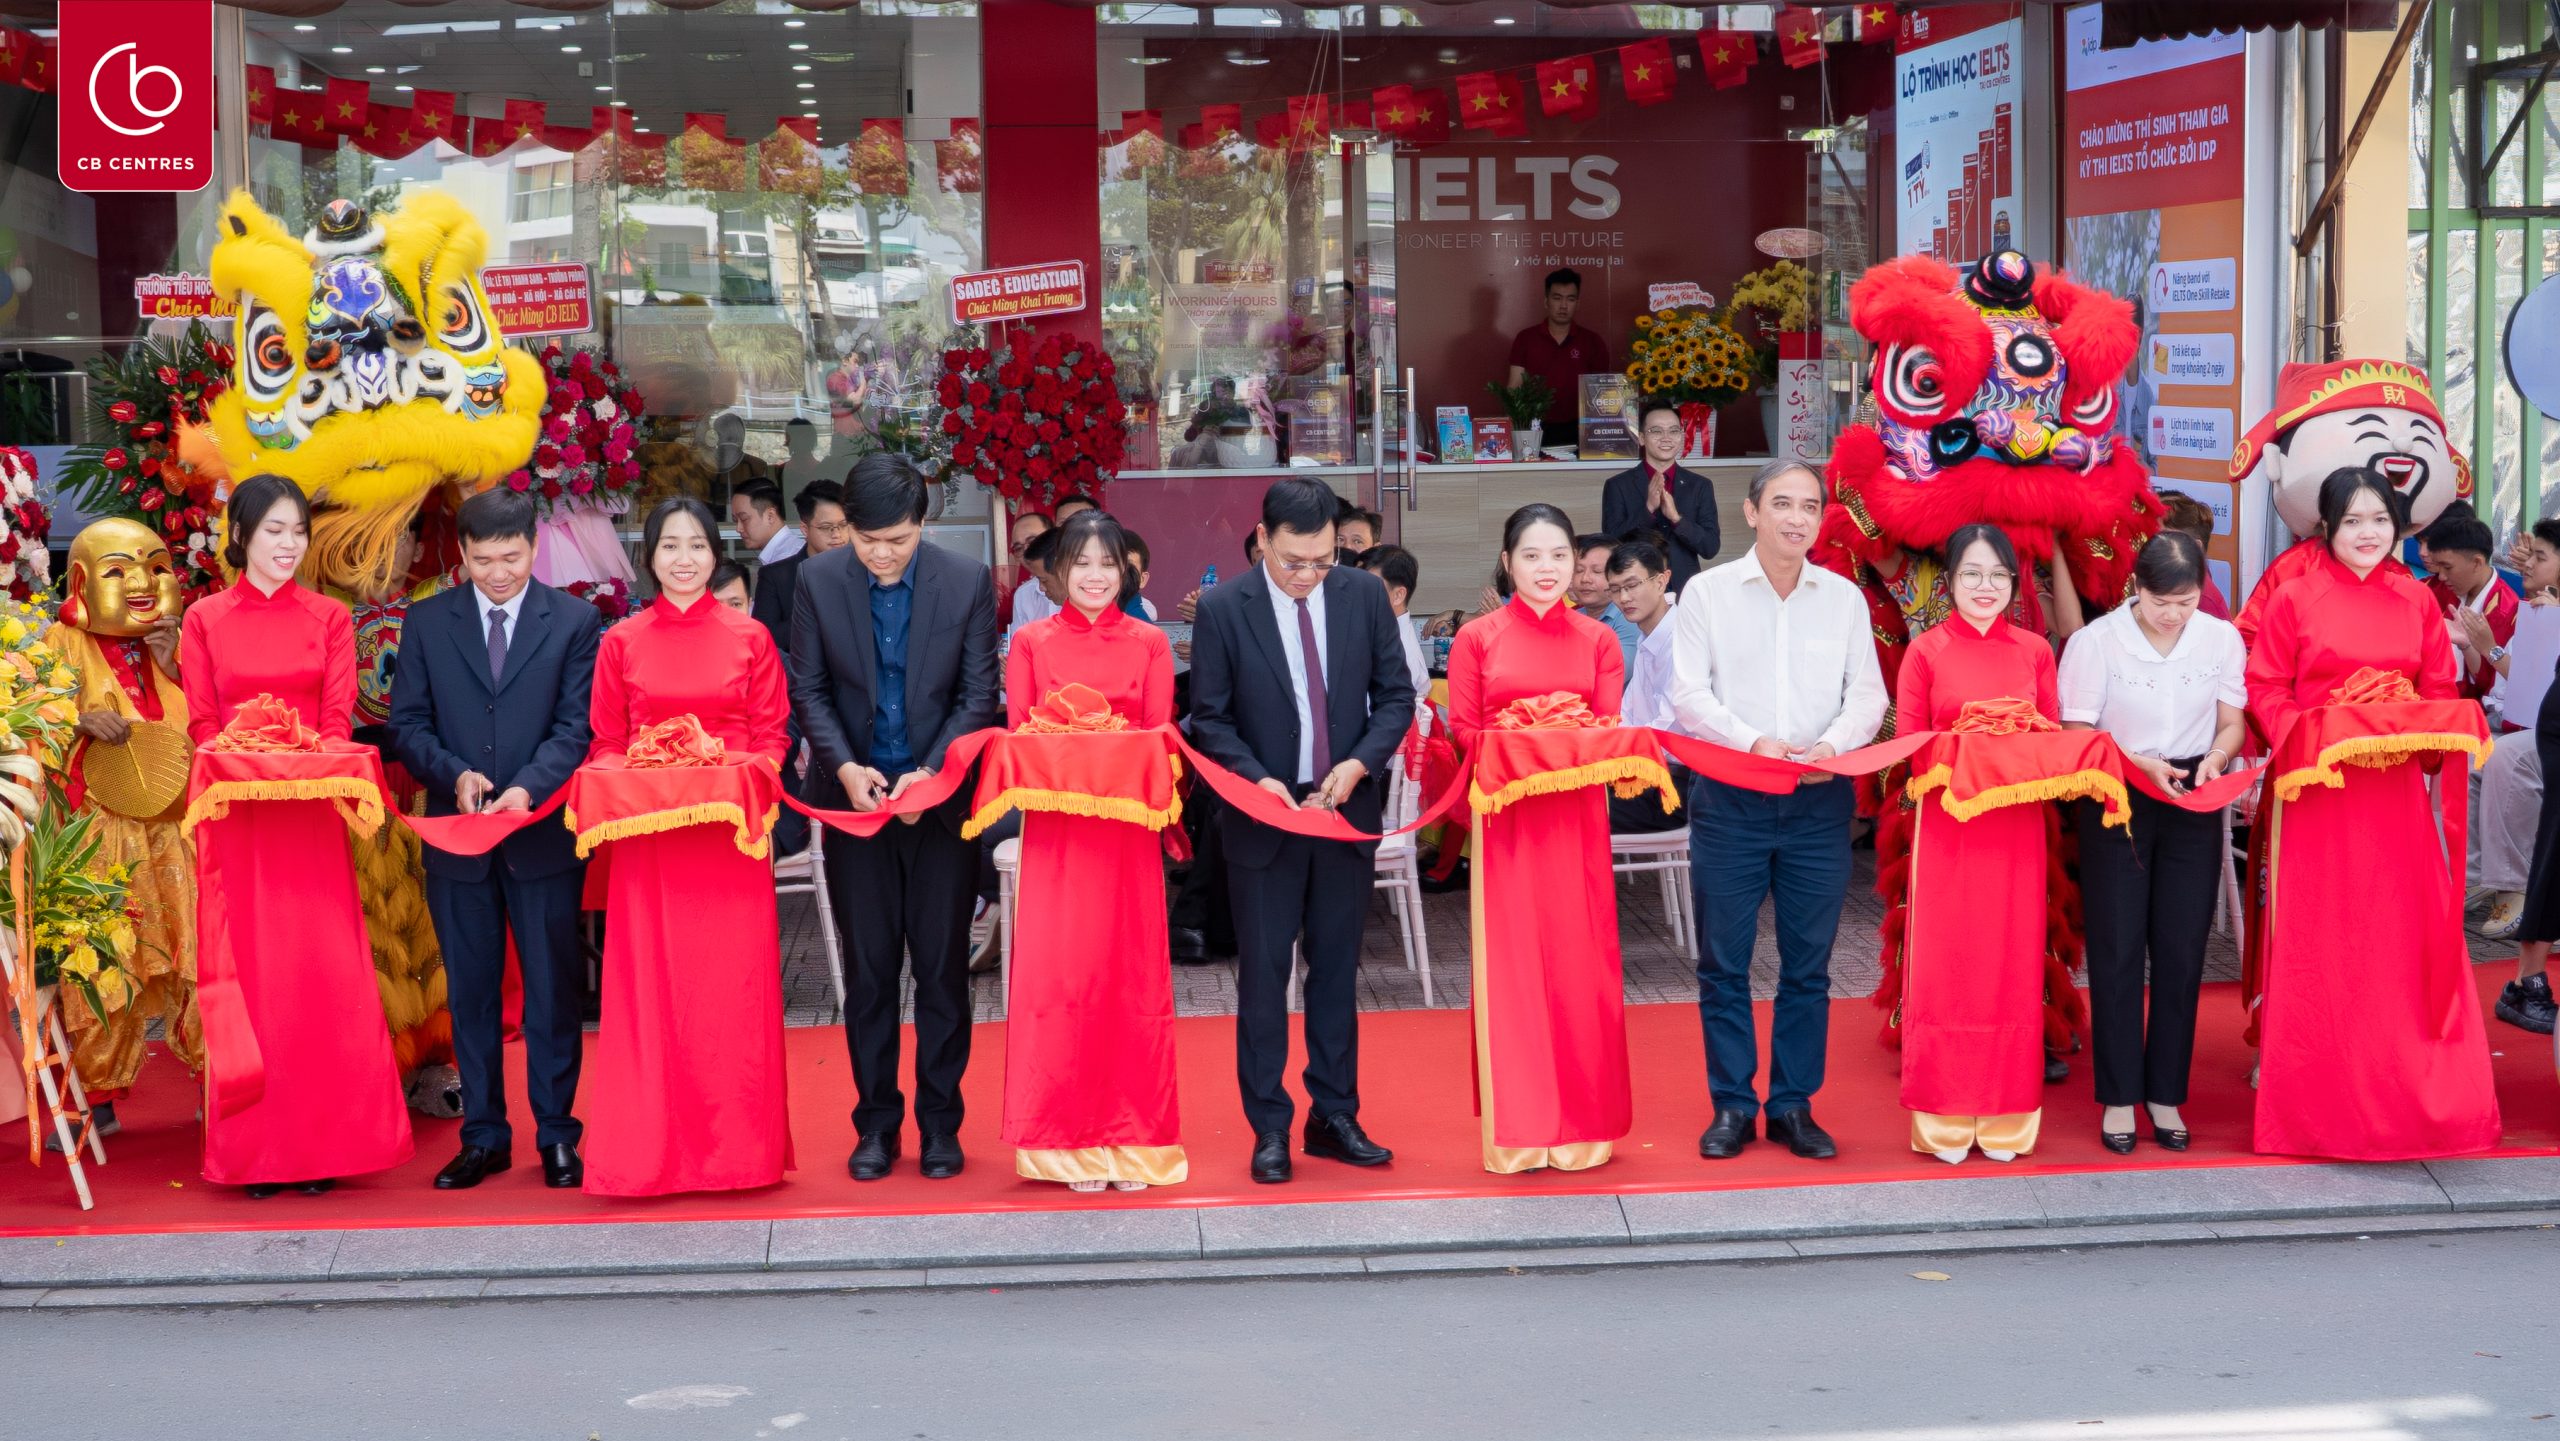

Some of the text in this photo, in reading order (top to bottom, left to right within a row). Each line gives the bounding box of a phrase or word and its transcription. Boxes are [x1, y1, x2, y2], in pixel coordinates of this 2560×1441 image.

[1902, 42, 2010, 103] LỘ TRÌNH HỌC IELTS
[2079, 104, 2229, 149] CHÀO MỪNG THÍ SINH THAM GIA
[2079, 136, 2217, 179] KỲ THI IELTS TỔ CHỨC BỞI IDP
[1395, 154, 1621, 221] IELTS
[1396, 231, 1625, 249] PIONEER THE FUTURE
[1522, 253, 1624, 268] Mở lối tương lai
[137, 272, 212, 299] TRƯỜNG TIỂU HỌC
[955, 269, 1079, 300] SADEC EDUCATION
[2187, 271, 2200, 284] band
[967, 293, 1074, 315] Chúc Mừng Khai Trương
[1168, 296, 1278, 306] WORKING HOURS
[2173, 287, 2229, 301] IELTS One Skill Retake
[156, 297, 204, 318] Chúc
[546, 305, 557, 323] CB
[559, 303, 580, 322] IELTS
[2172, 363, 2186, 377] trong
[2383, 385, 2407, 406] 財
